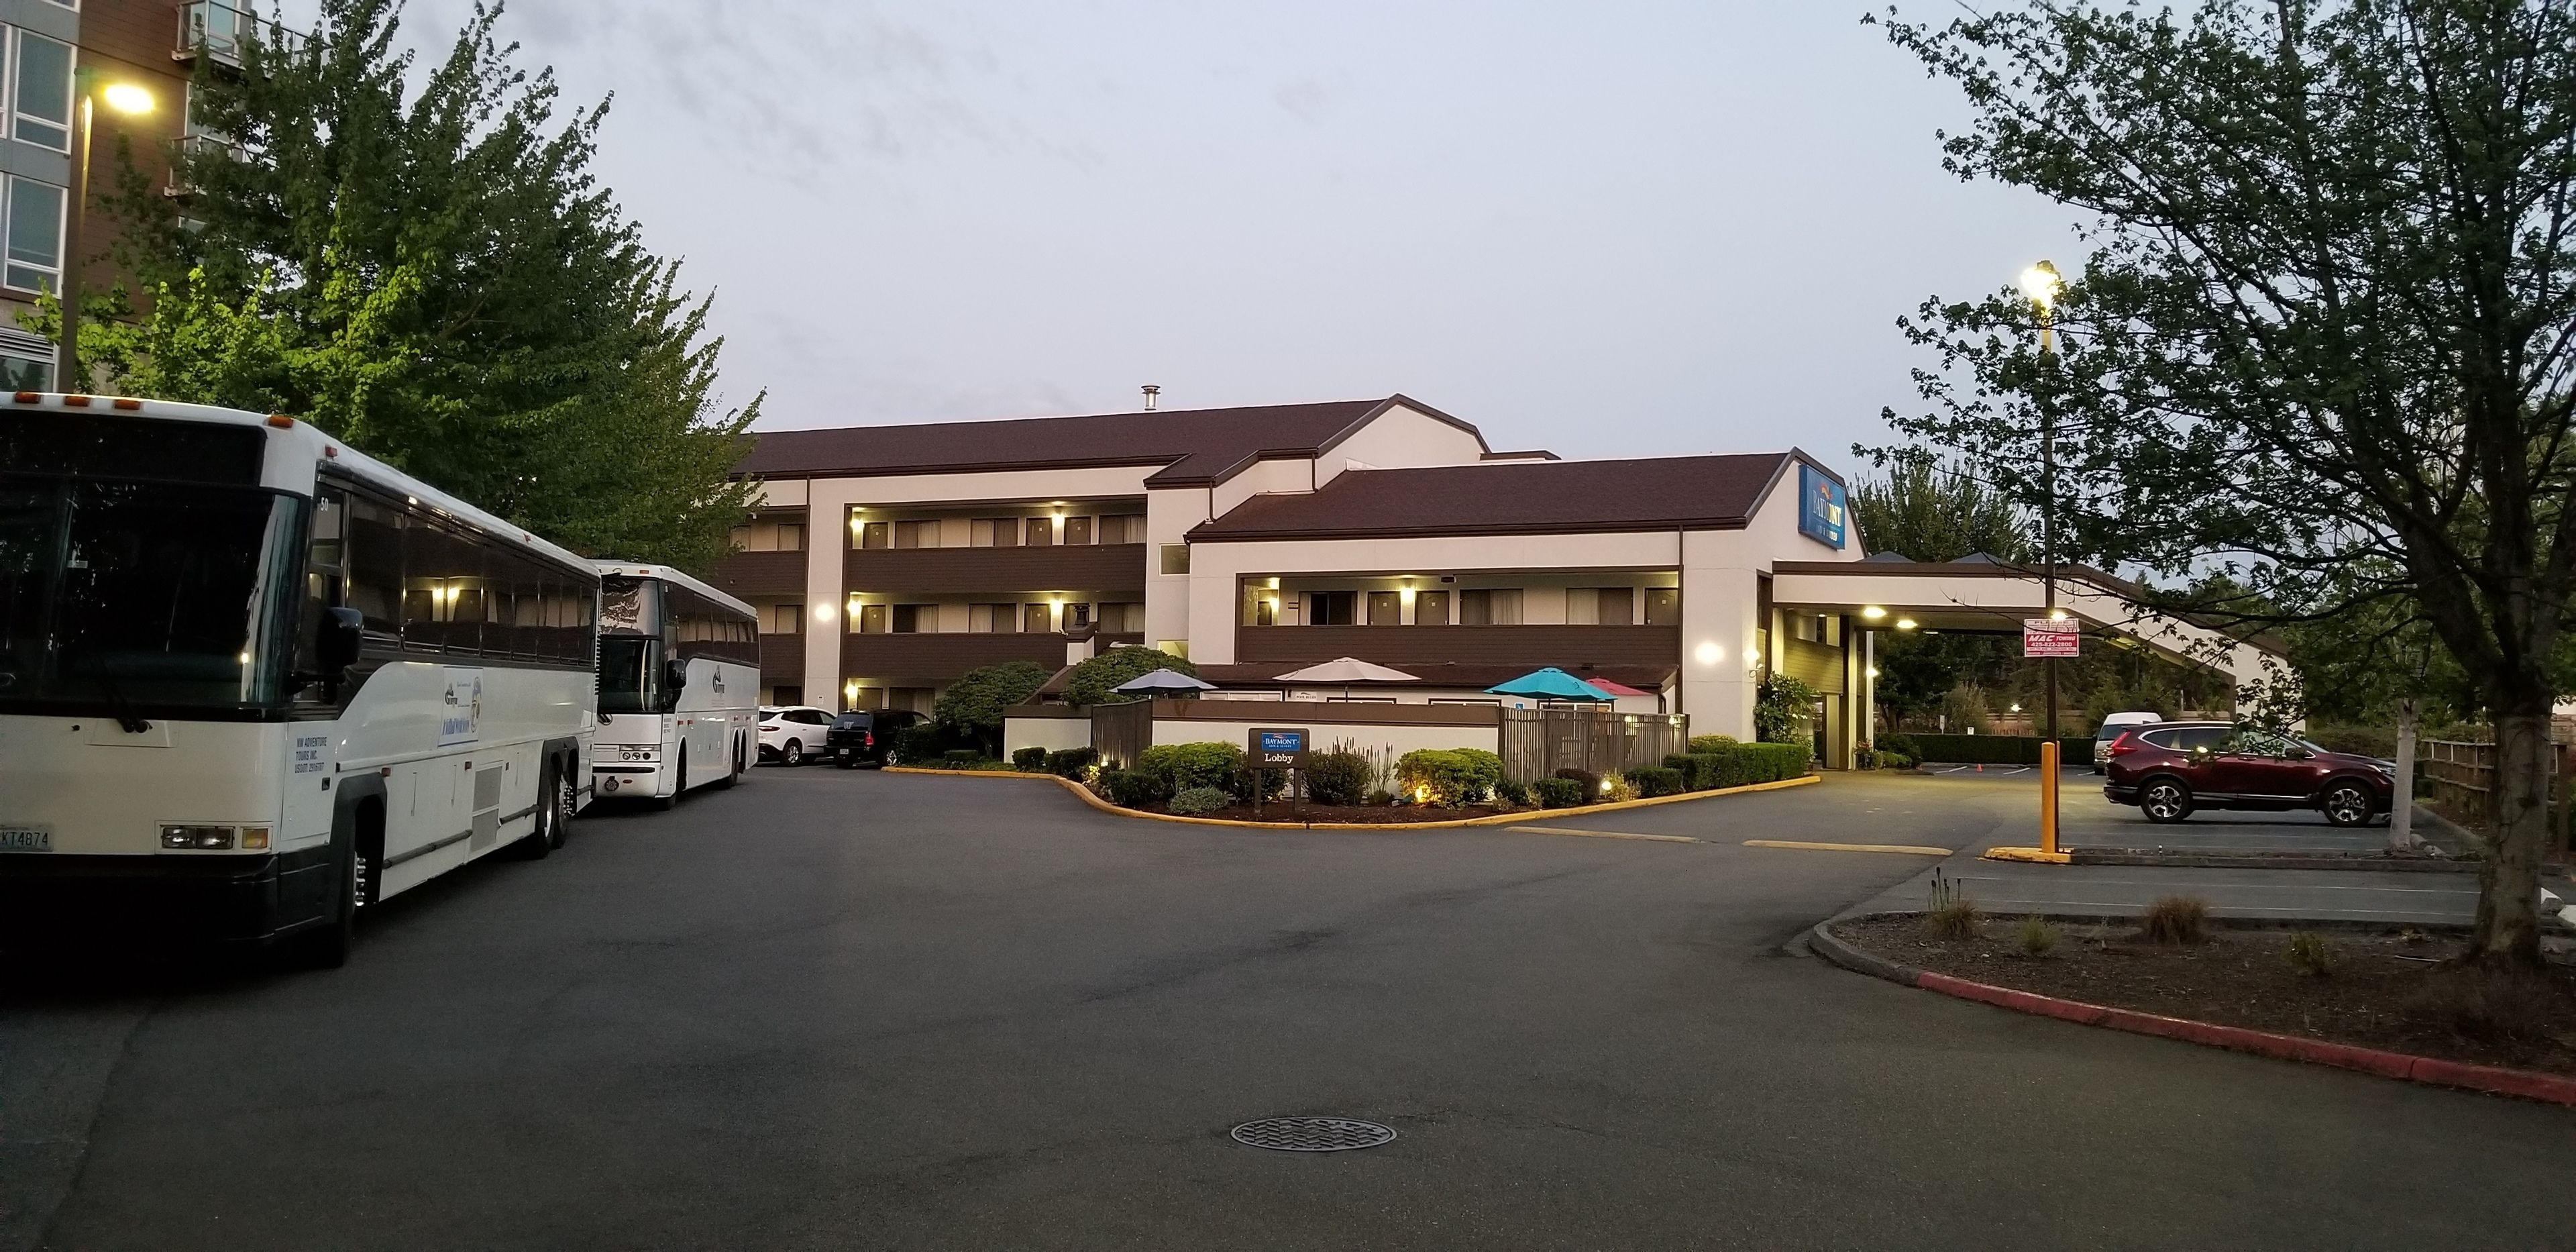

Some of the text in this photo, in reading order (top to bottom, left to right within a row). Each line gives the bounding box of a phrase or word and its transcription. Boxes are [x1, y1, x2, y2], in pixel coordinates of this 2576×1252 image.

[321, 497, 329, 511] 50
[1813, 490, 1841, 527] BAYMONT
[304, 737, 327, 747] ADVENTURE
[296, 751, 309, 761] TOURS
[1265, 753, 1294, 764] Lobby
